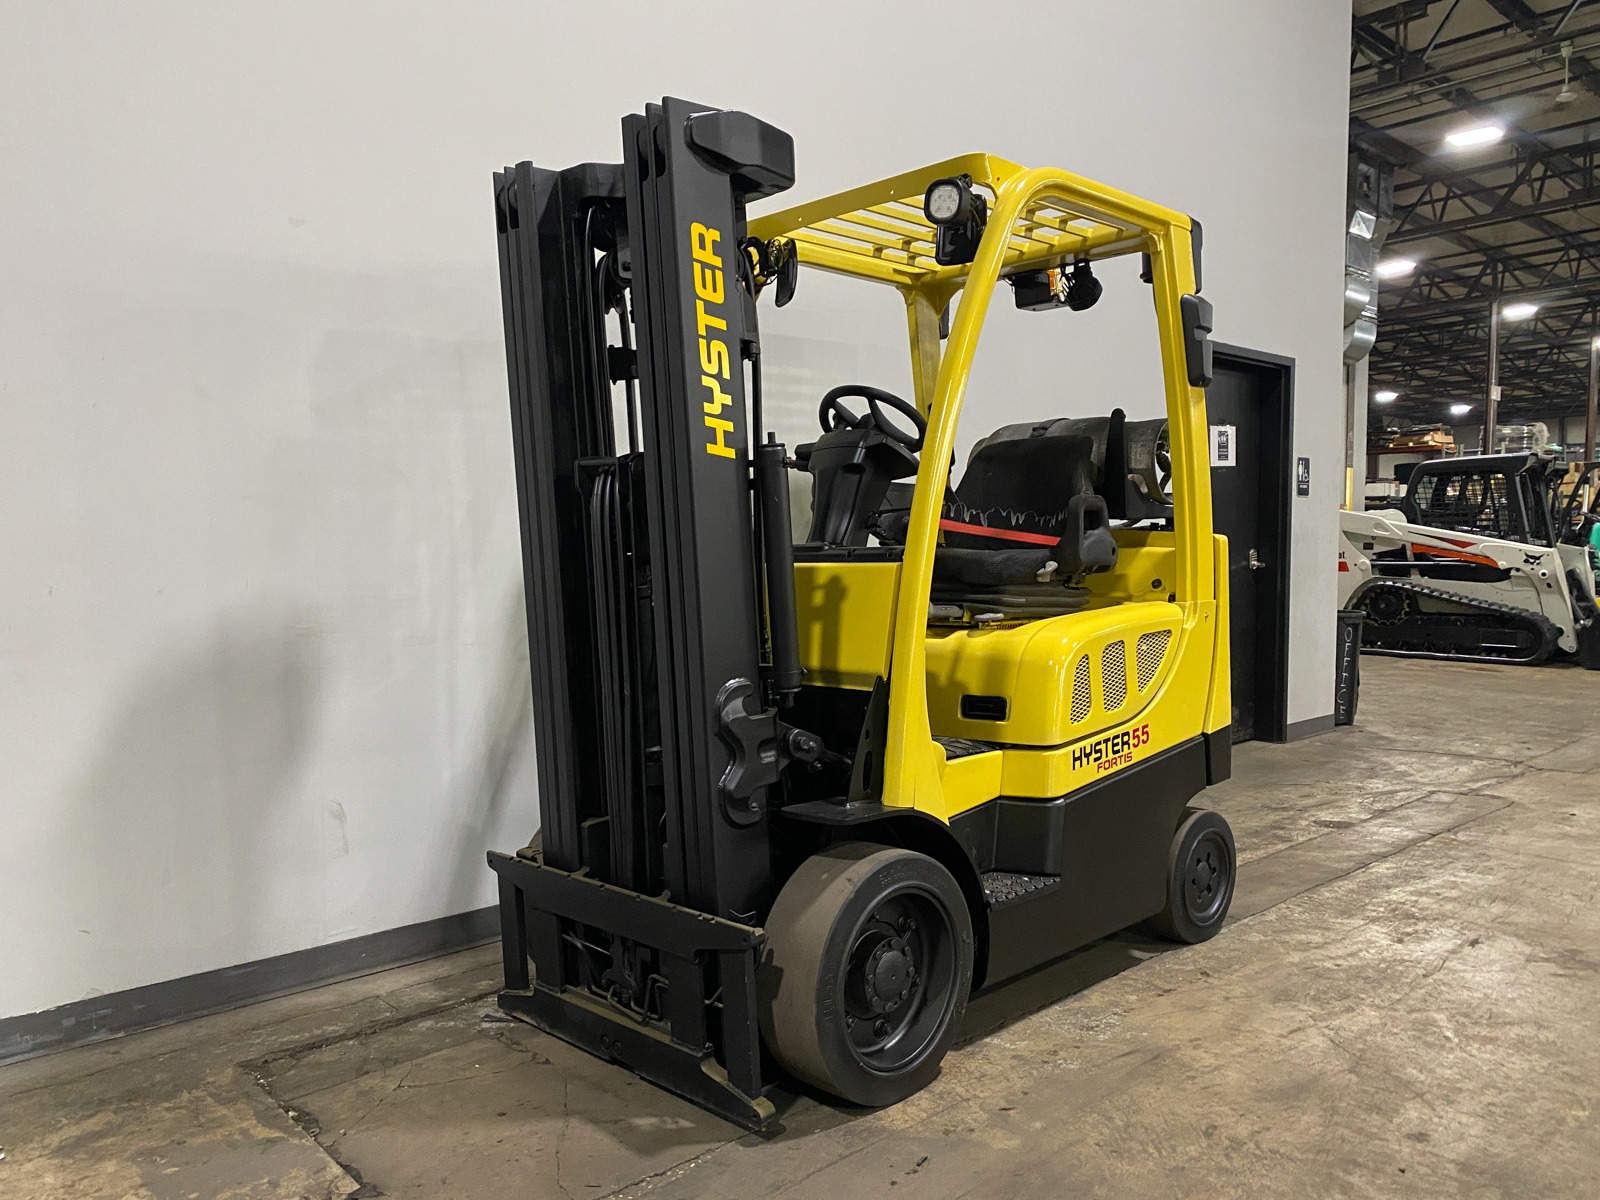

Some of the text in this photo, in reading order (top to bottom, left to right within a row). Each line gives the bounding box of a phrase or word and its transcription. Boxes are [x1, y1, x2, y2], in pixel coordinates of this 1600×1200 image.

[690, 221, 736, 459] HYSTER
[1336, 627, 1353, 719] OFFICE
[1072, 723, 1150, 771] HYSTER 55
[1096, 751, 1133, 774] FORTIS
